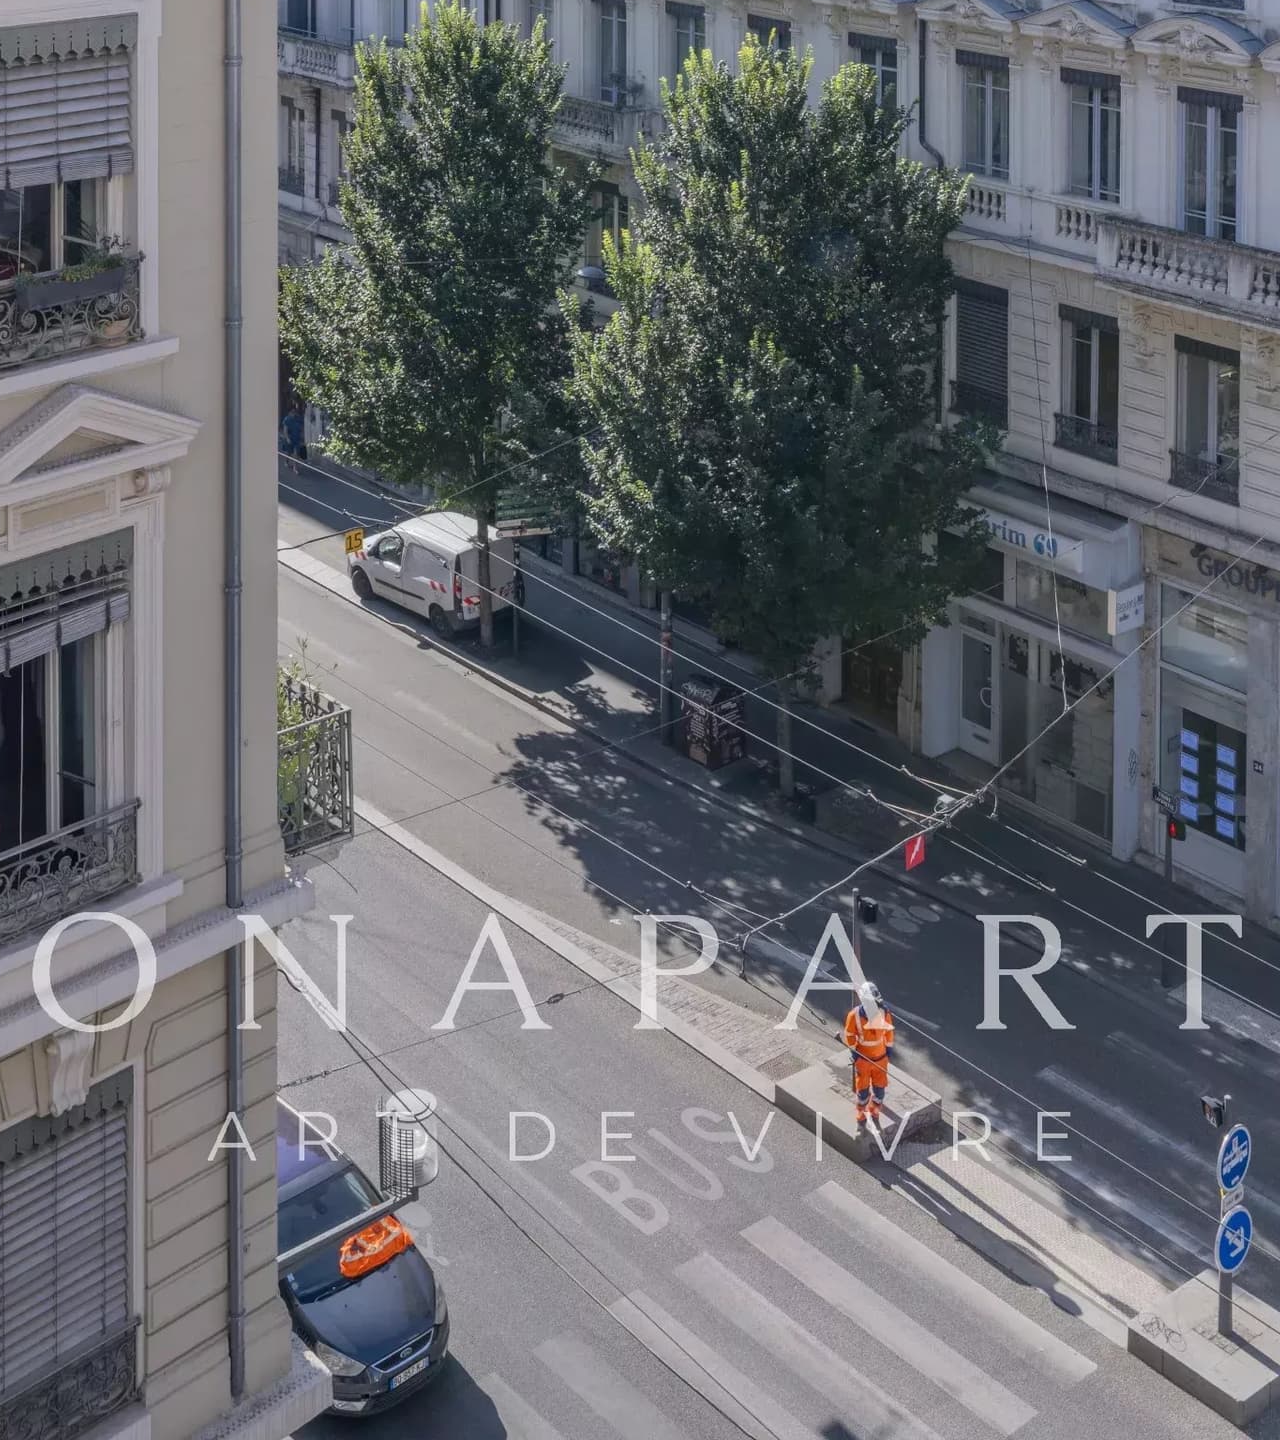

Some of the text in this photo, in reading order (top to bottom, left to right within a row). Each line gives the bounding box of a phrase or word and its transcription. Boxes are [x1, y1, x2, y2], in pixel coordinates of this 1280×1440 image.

[346, 532, 362, 550] 15
[1033, 533, 1058, 559] 69
[570, 1107, 774, 1235] BUS
